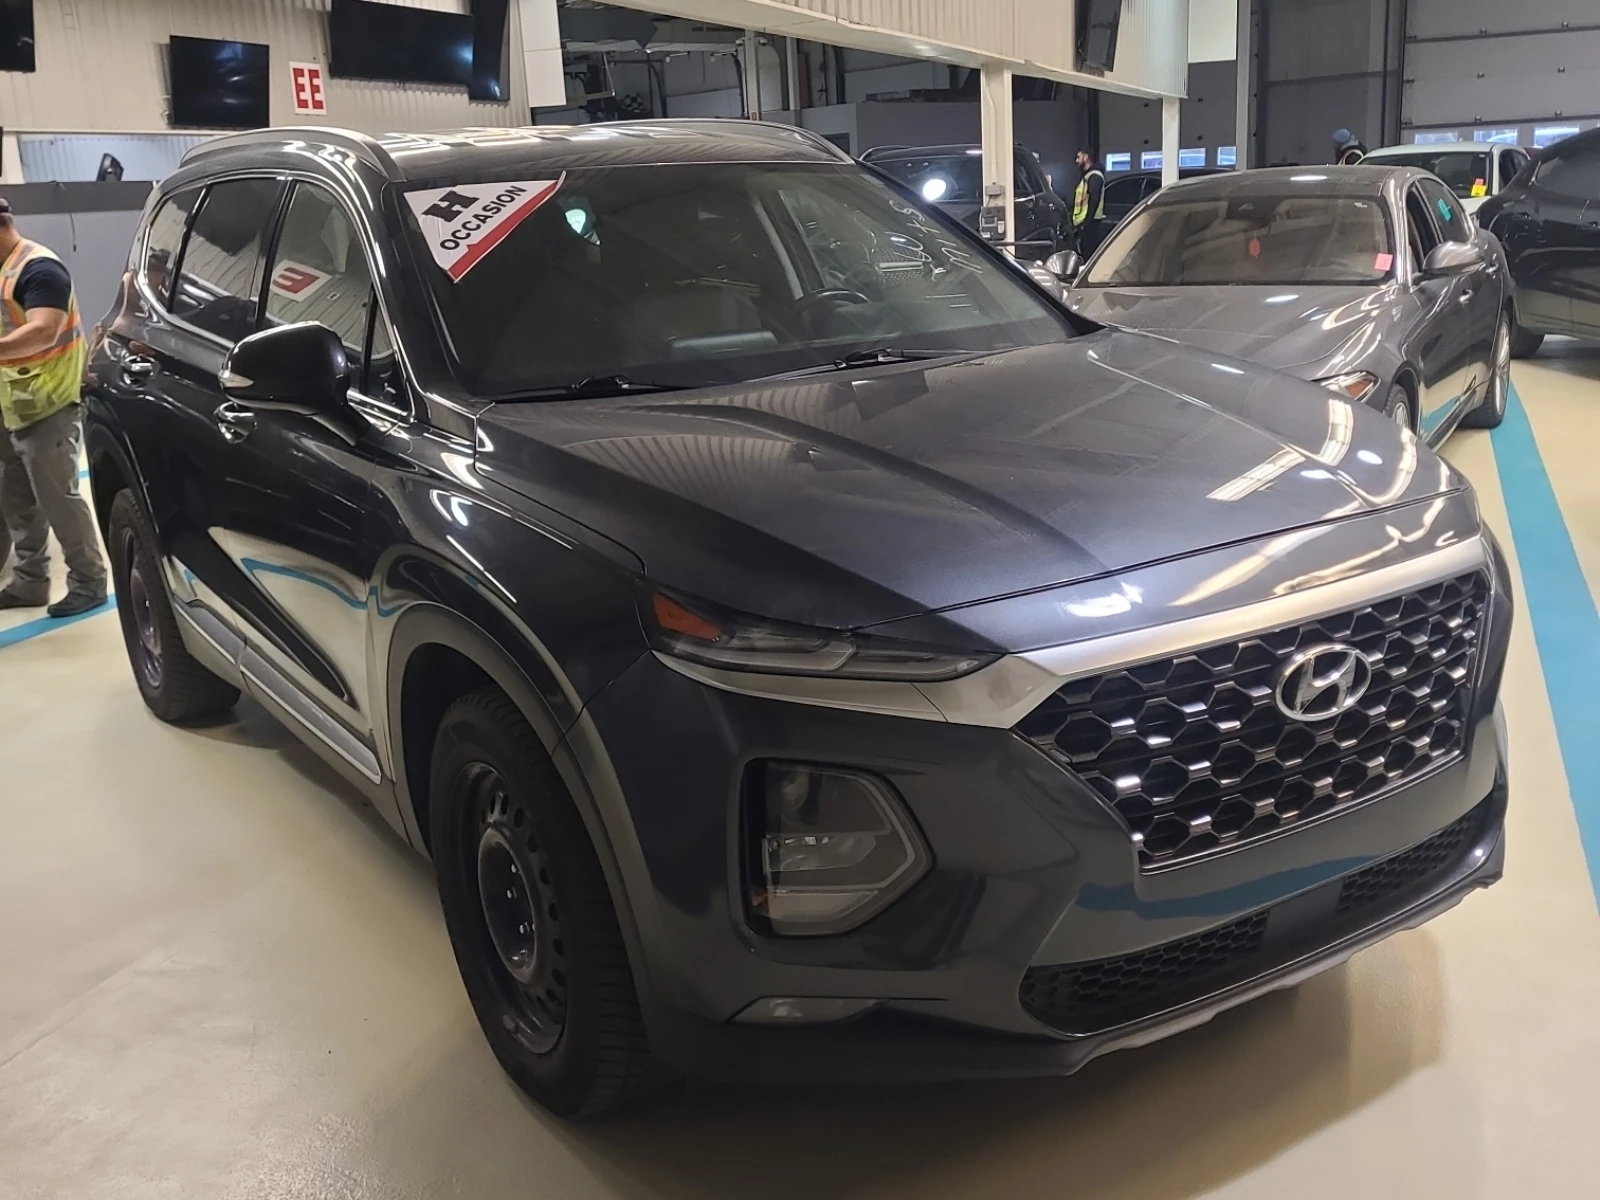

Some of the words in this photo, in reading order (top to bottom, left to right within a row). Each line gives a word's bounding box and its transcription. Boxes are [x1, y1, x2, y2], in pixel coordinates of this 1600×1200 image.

[292, 68, 324, 109] EE
[421, 190, 480, 223] H
[440, 186, 527, 251] OCCASION
